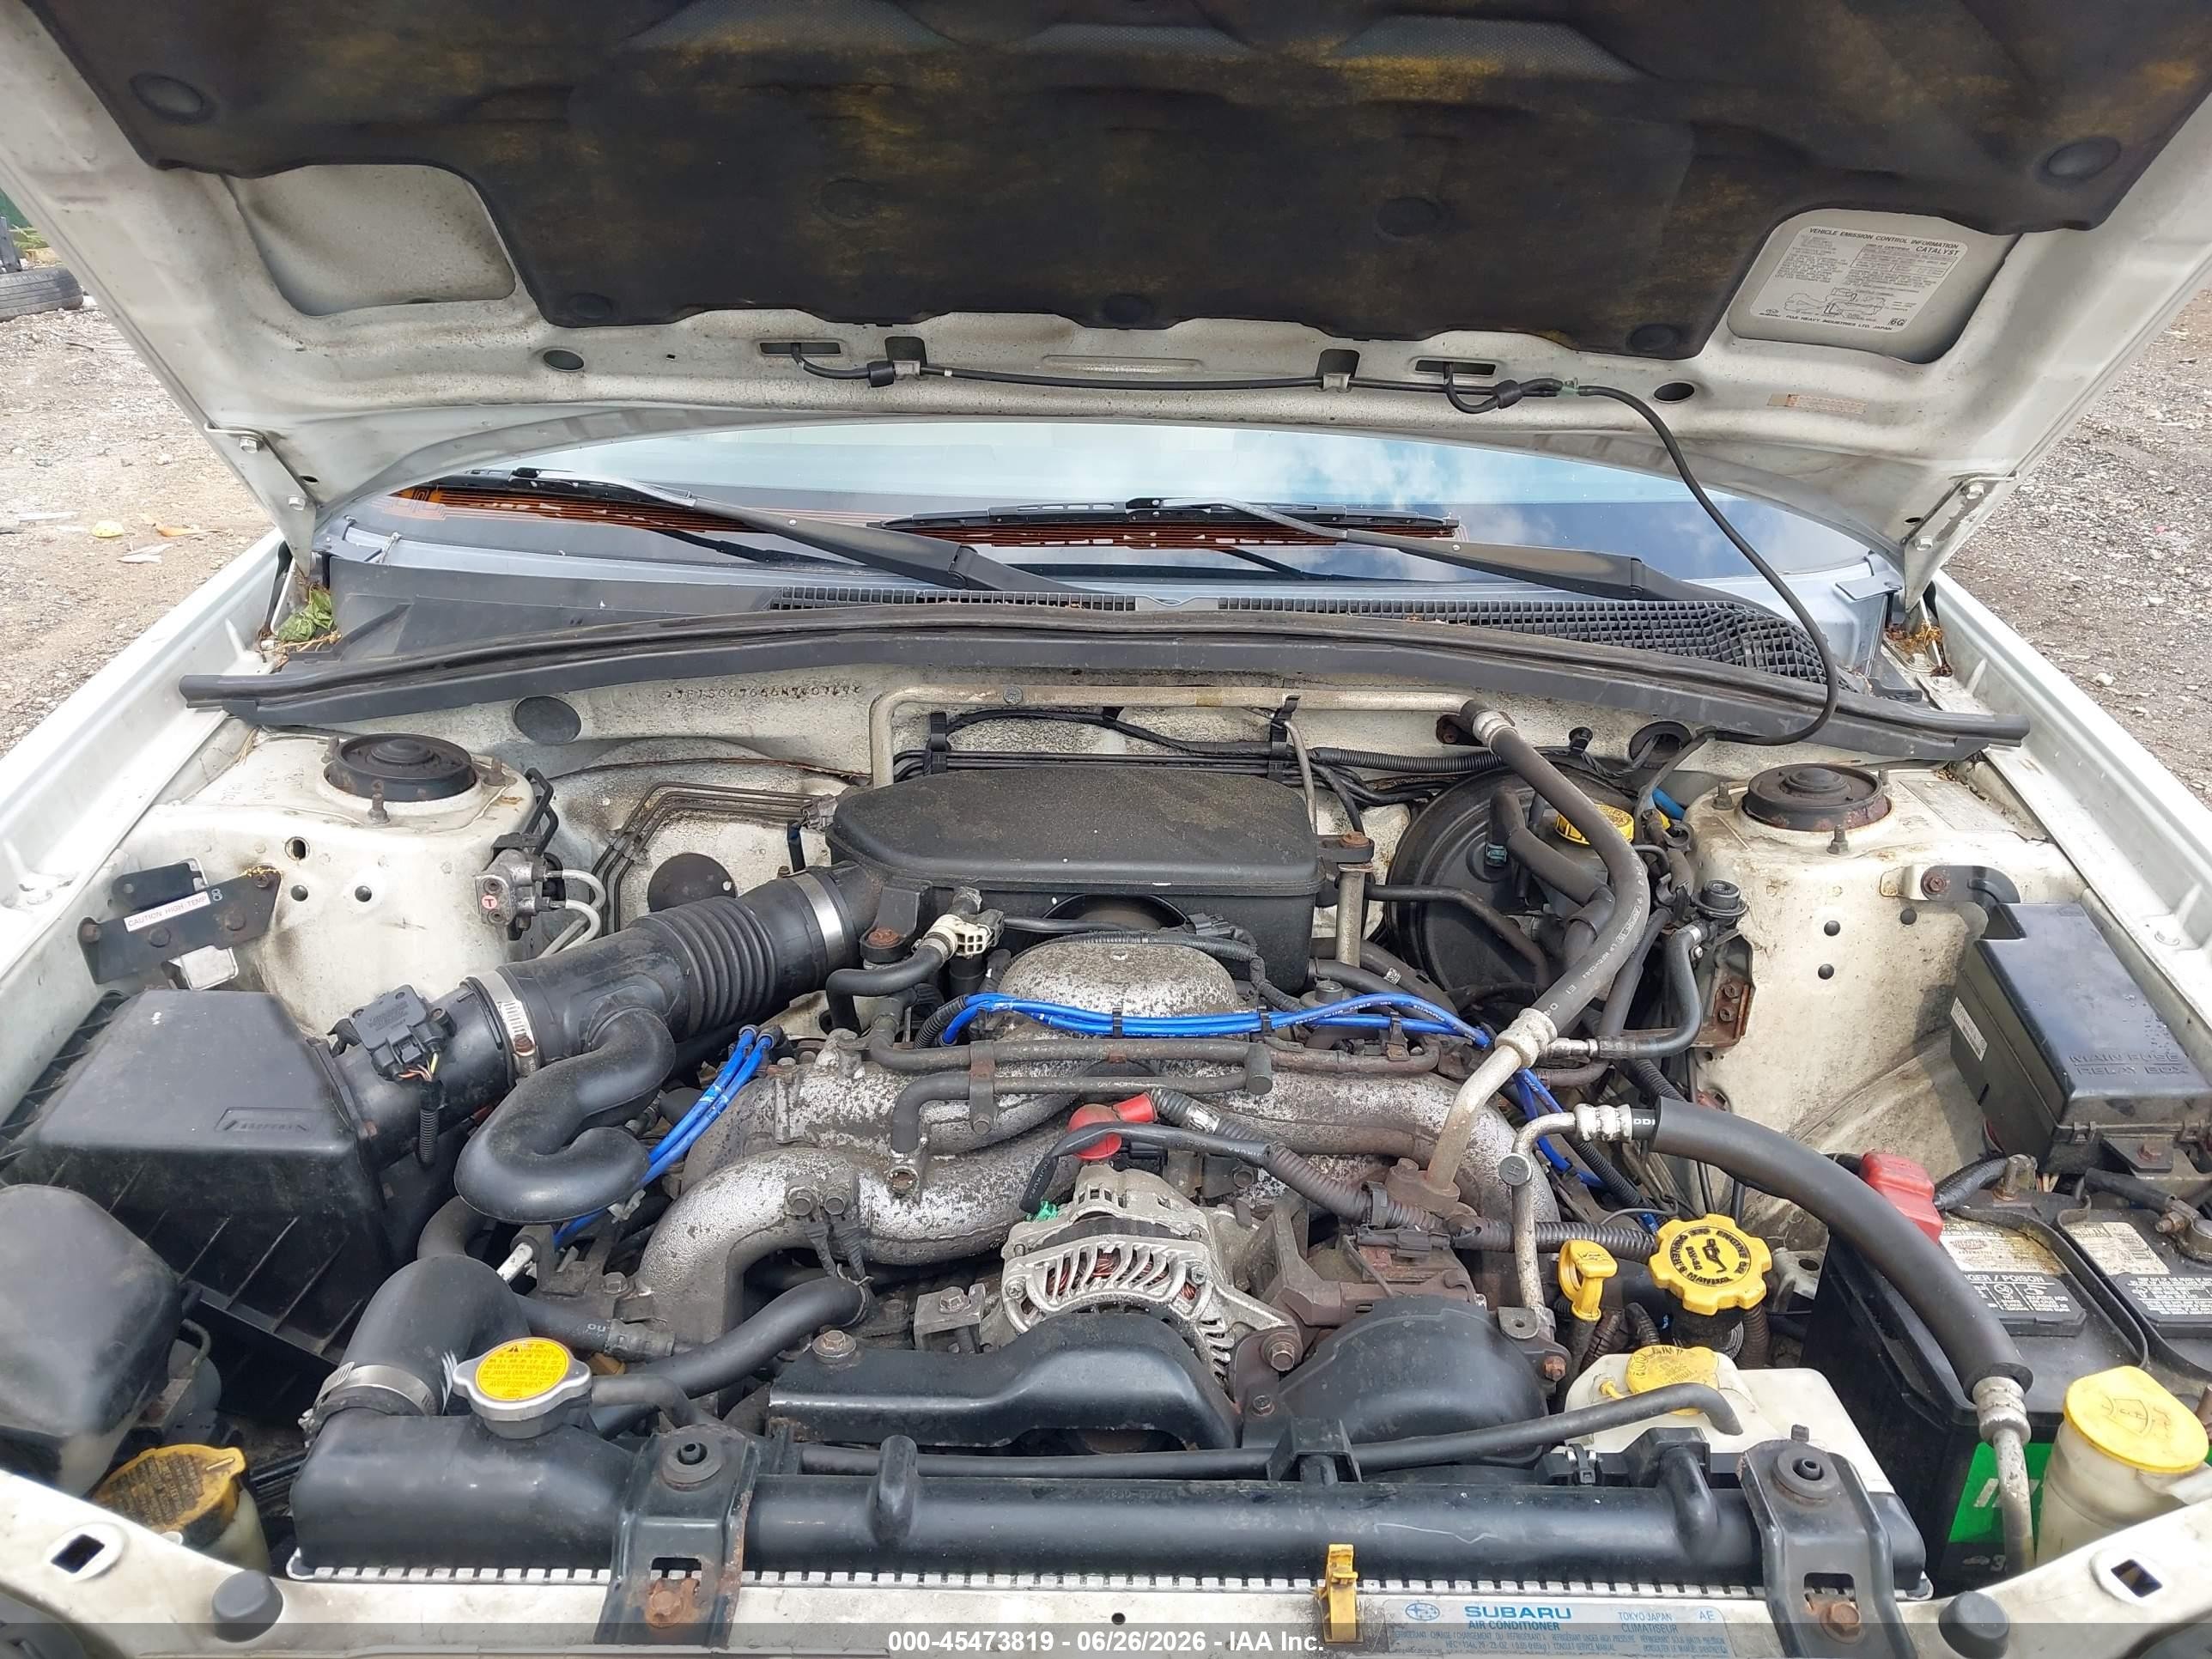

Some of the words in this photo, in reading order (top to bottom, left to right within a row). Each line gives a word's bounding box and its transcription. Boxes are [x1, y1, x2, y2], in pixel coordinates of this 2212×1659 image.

[1809, 228, 1837, 236] VEHICLE
[1840, 231, 1874, 240] EMISSION
[1875, 235, 1908, 244] CONTROL
[1911, 240, 1959, 249] INFORMATION
[1916, 246, 1960, 256] CATALYST
[484, 898, 495, 907] T
[128, 910, 162, 927] CAUTION
[165, 902, 185, 915] HIGH
[187, 896, 207, 907] TEMP
[1464, 1606, 1572, 1620] SUBARU
[1619, 1611, 1645, 1622] TOKYO
[1646, 1612, 1674, 1622] JAPAN
[1698, 1610, 1715, 1621] AE
[1468, 1620, 1486, 1630] AIR
[1489, 1620, 1560, 1631] CONDITIONER
[1621, 1622, 1678, 1633] CLIMATISEUR
